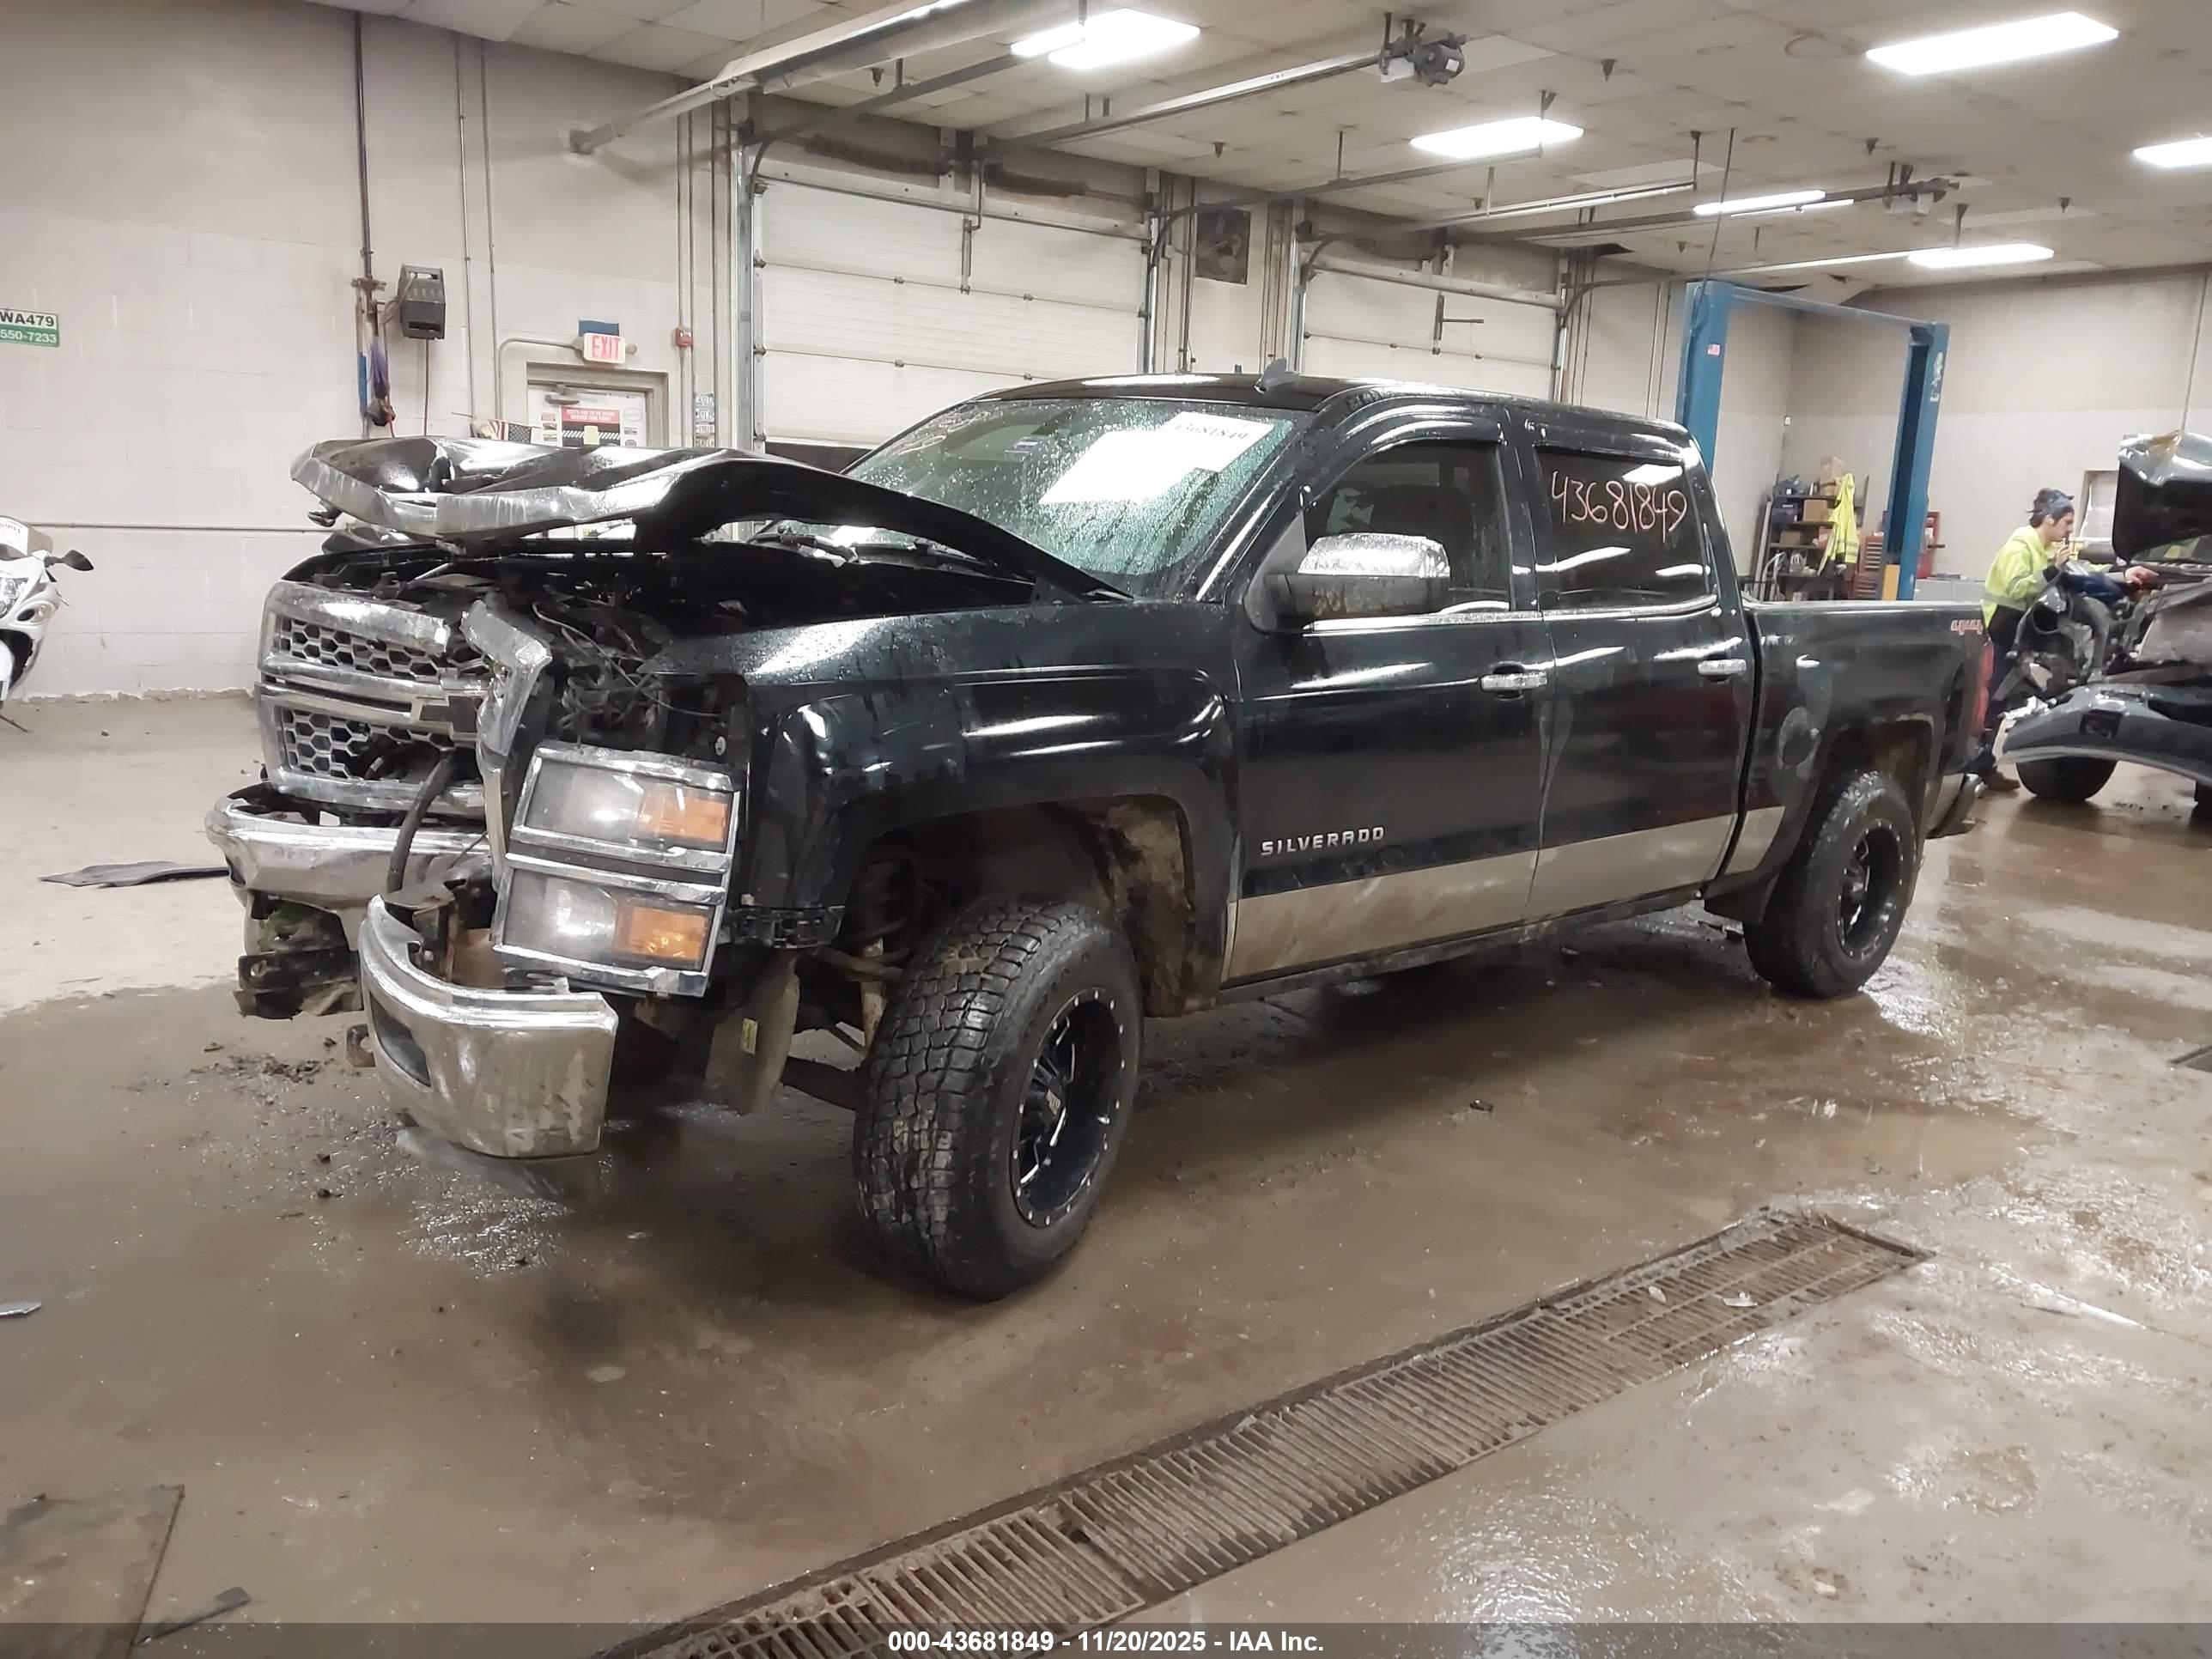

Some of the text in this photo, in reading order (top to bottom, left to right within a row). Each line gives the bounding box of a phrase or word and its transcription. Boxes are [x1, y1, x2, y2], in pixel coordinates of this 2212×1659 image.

[0, 312, 55, 328] WA479
[0, 329, 57, 343] 550-7233
[591, 335, 621, 361] EXIT
[1551, 470, 1688, 544] 43681849
[1260, 826, 1385, 856] SILVERADO
